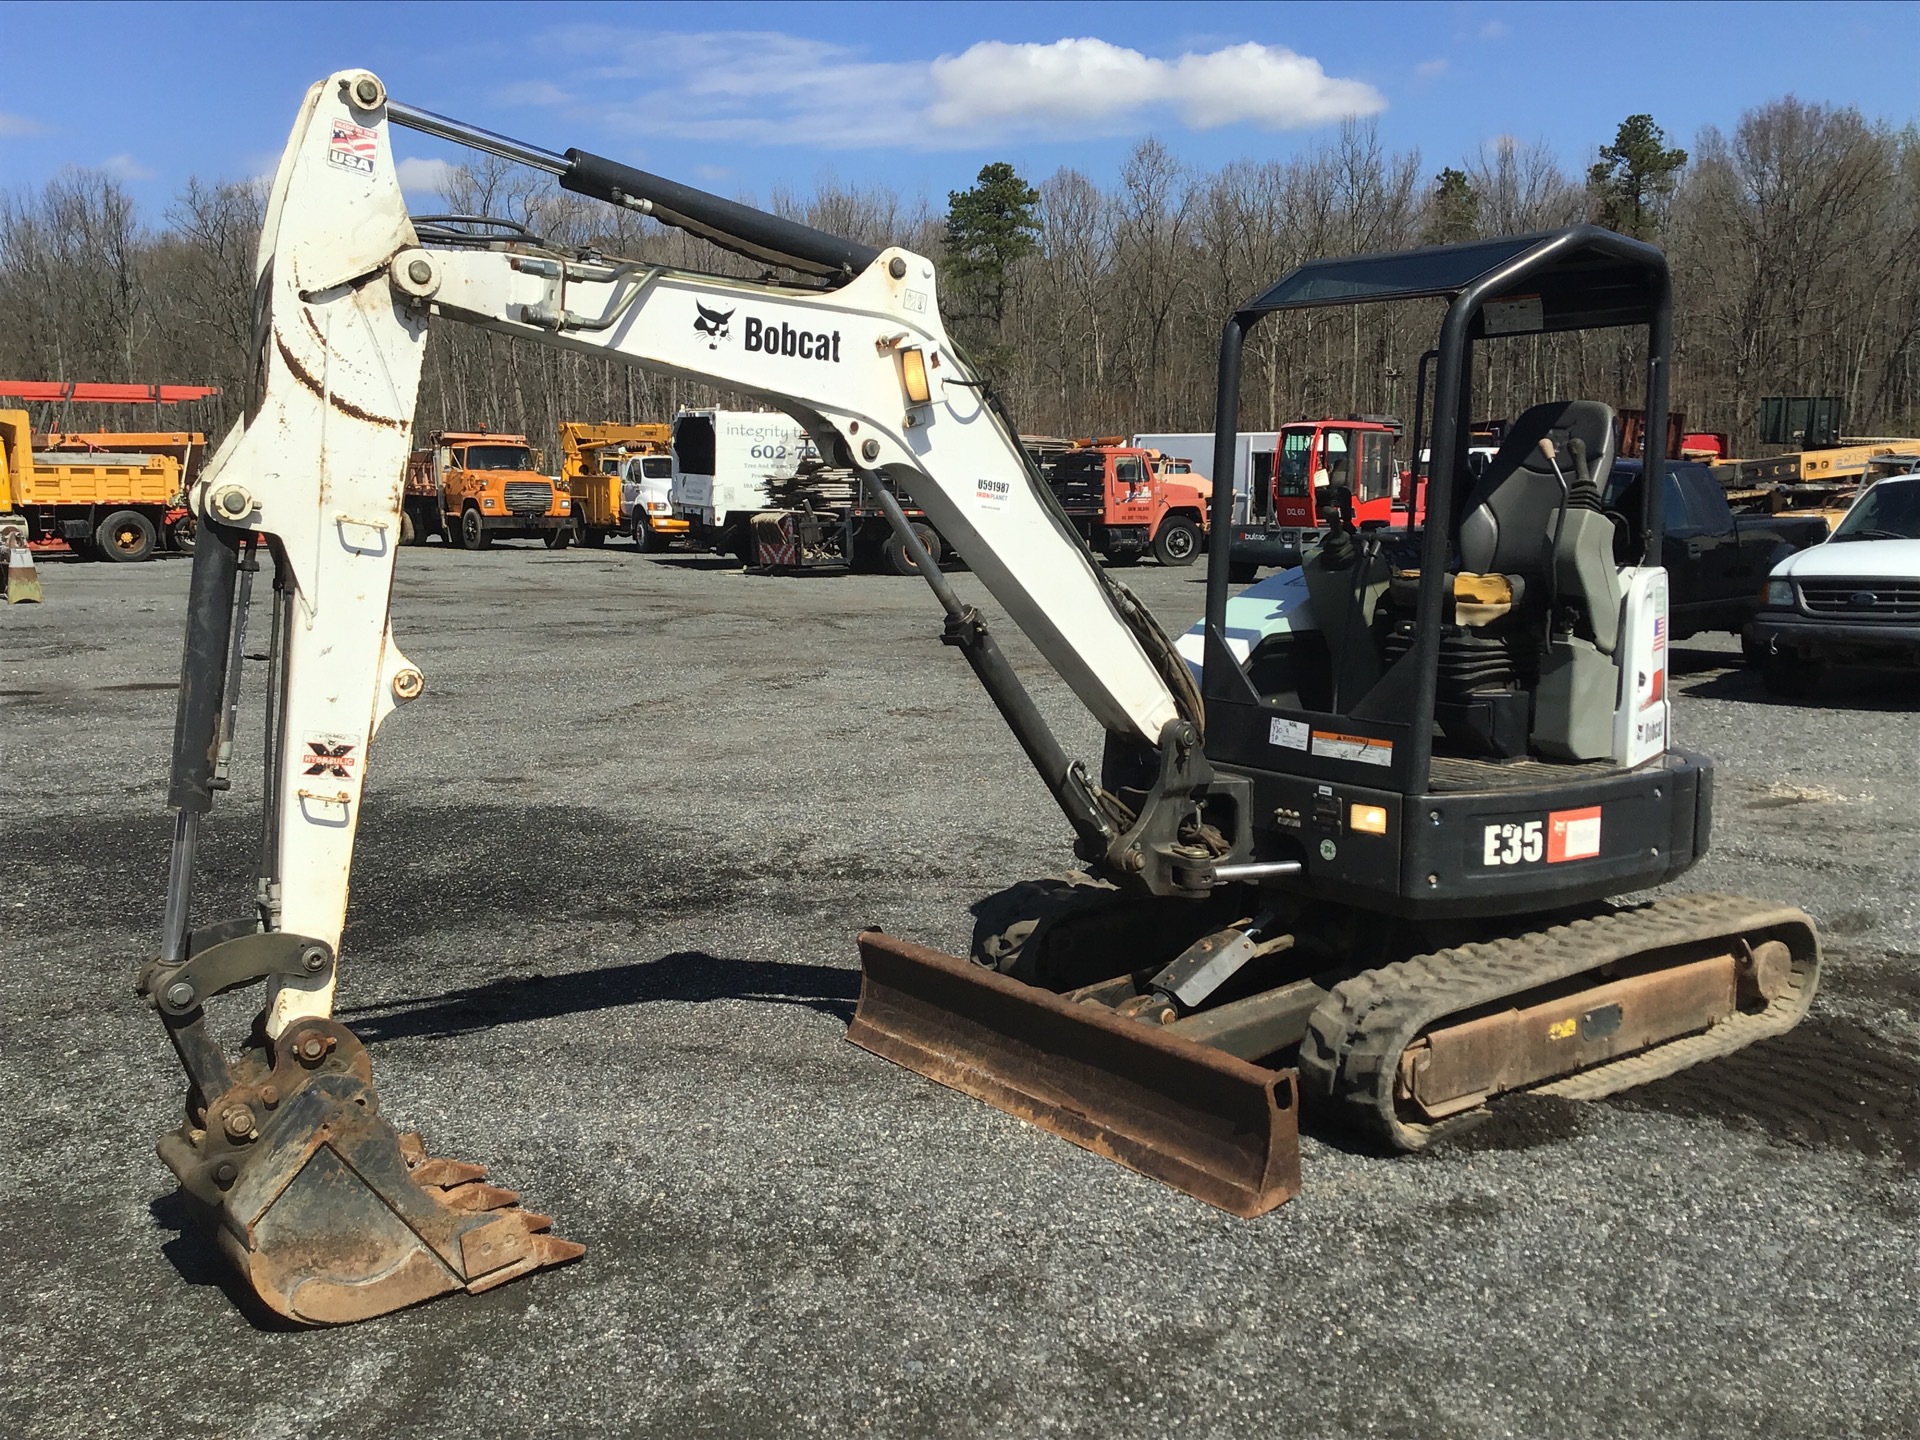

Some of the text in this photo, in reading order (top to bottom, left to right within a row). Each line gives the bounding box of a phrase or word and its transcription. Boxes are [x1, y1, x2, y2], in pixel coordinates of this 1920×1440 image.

[330, 149, 371, 172] USA
[744, 316, 841, 363] Bobcat
[726, 422, 789, 443] integrity
[978, 478, 1010, 493] U591987
[1645, 715, 1664, 744] Bobcat
[304, 755, 354, 766] HYDRAULIC
[1484, 820, 1544, 866] E35
